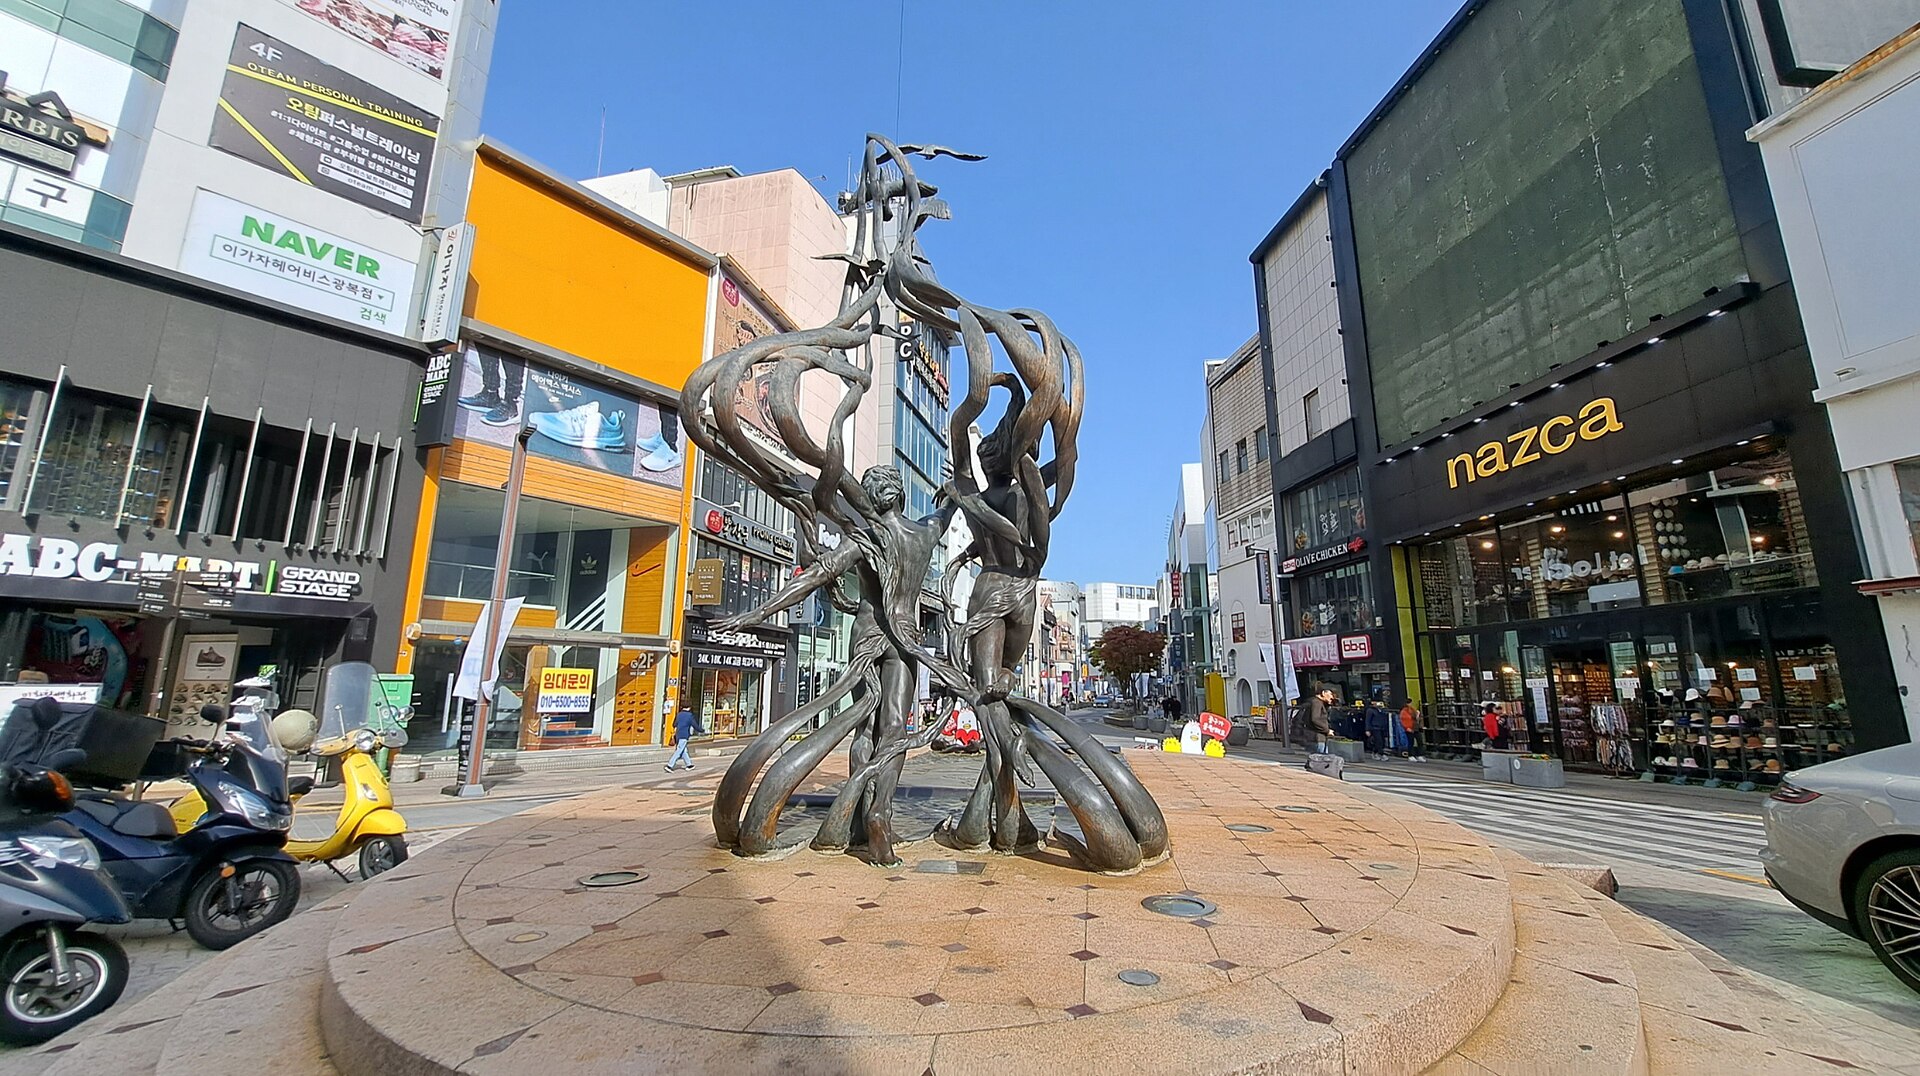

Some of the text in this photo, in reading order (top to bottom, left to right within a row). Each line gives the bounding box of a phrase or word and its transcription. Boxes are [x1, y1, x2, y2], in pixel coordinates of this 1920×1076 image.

[250, 41, 283, 63] 4F
[247, 62, 423, 127] OTEAM PERSONAL TRAINING
[286, 97, 421, 164] 오팀퍼스널트레이닝
[241, 215, 381, 280] NAVER
[222, 243, 374, 300] 이가자헤어비스광복점
[360, 306, 387, 325] 검색
[427, 354, 451, 372] ABC
[425, 369, 449, 382] MART
[1446, 397, 1624, 489] nazca
[282, 566, 360, 585] GRAND
[280, 580, 352, 597] STAGE
[638, 652, 655, 669] 2F
[544, 672, 590, 690] 임대문의
[540, 695, 589, 708] 010-6500-8555
